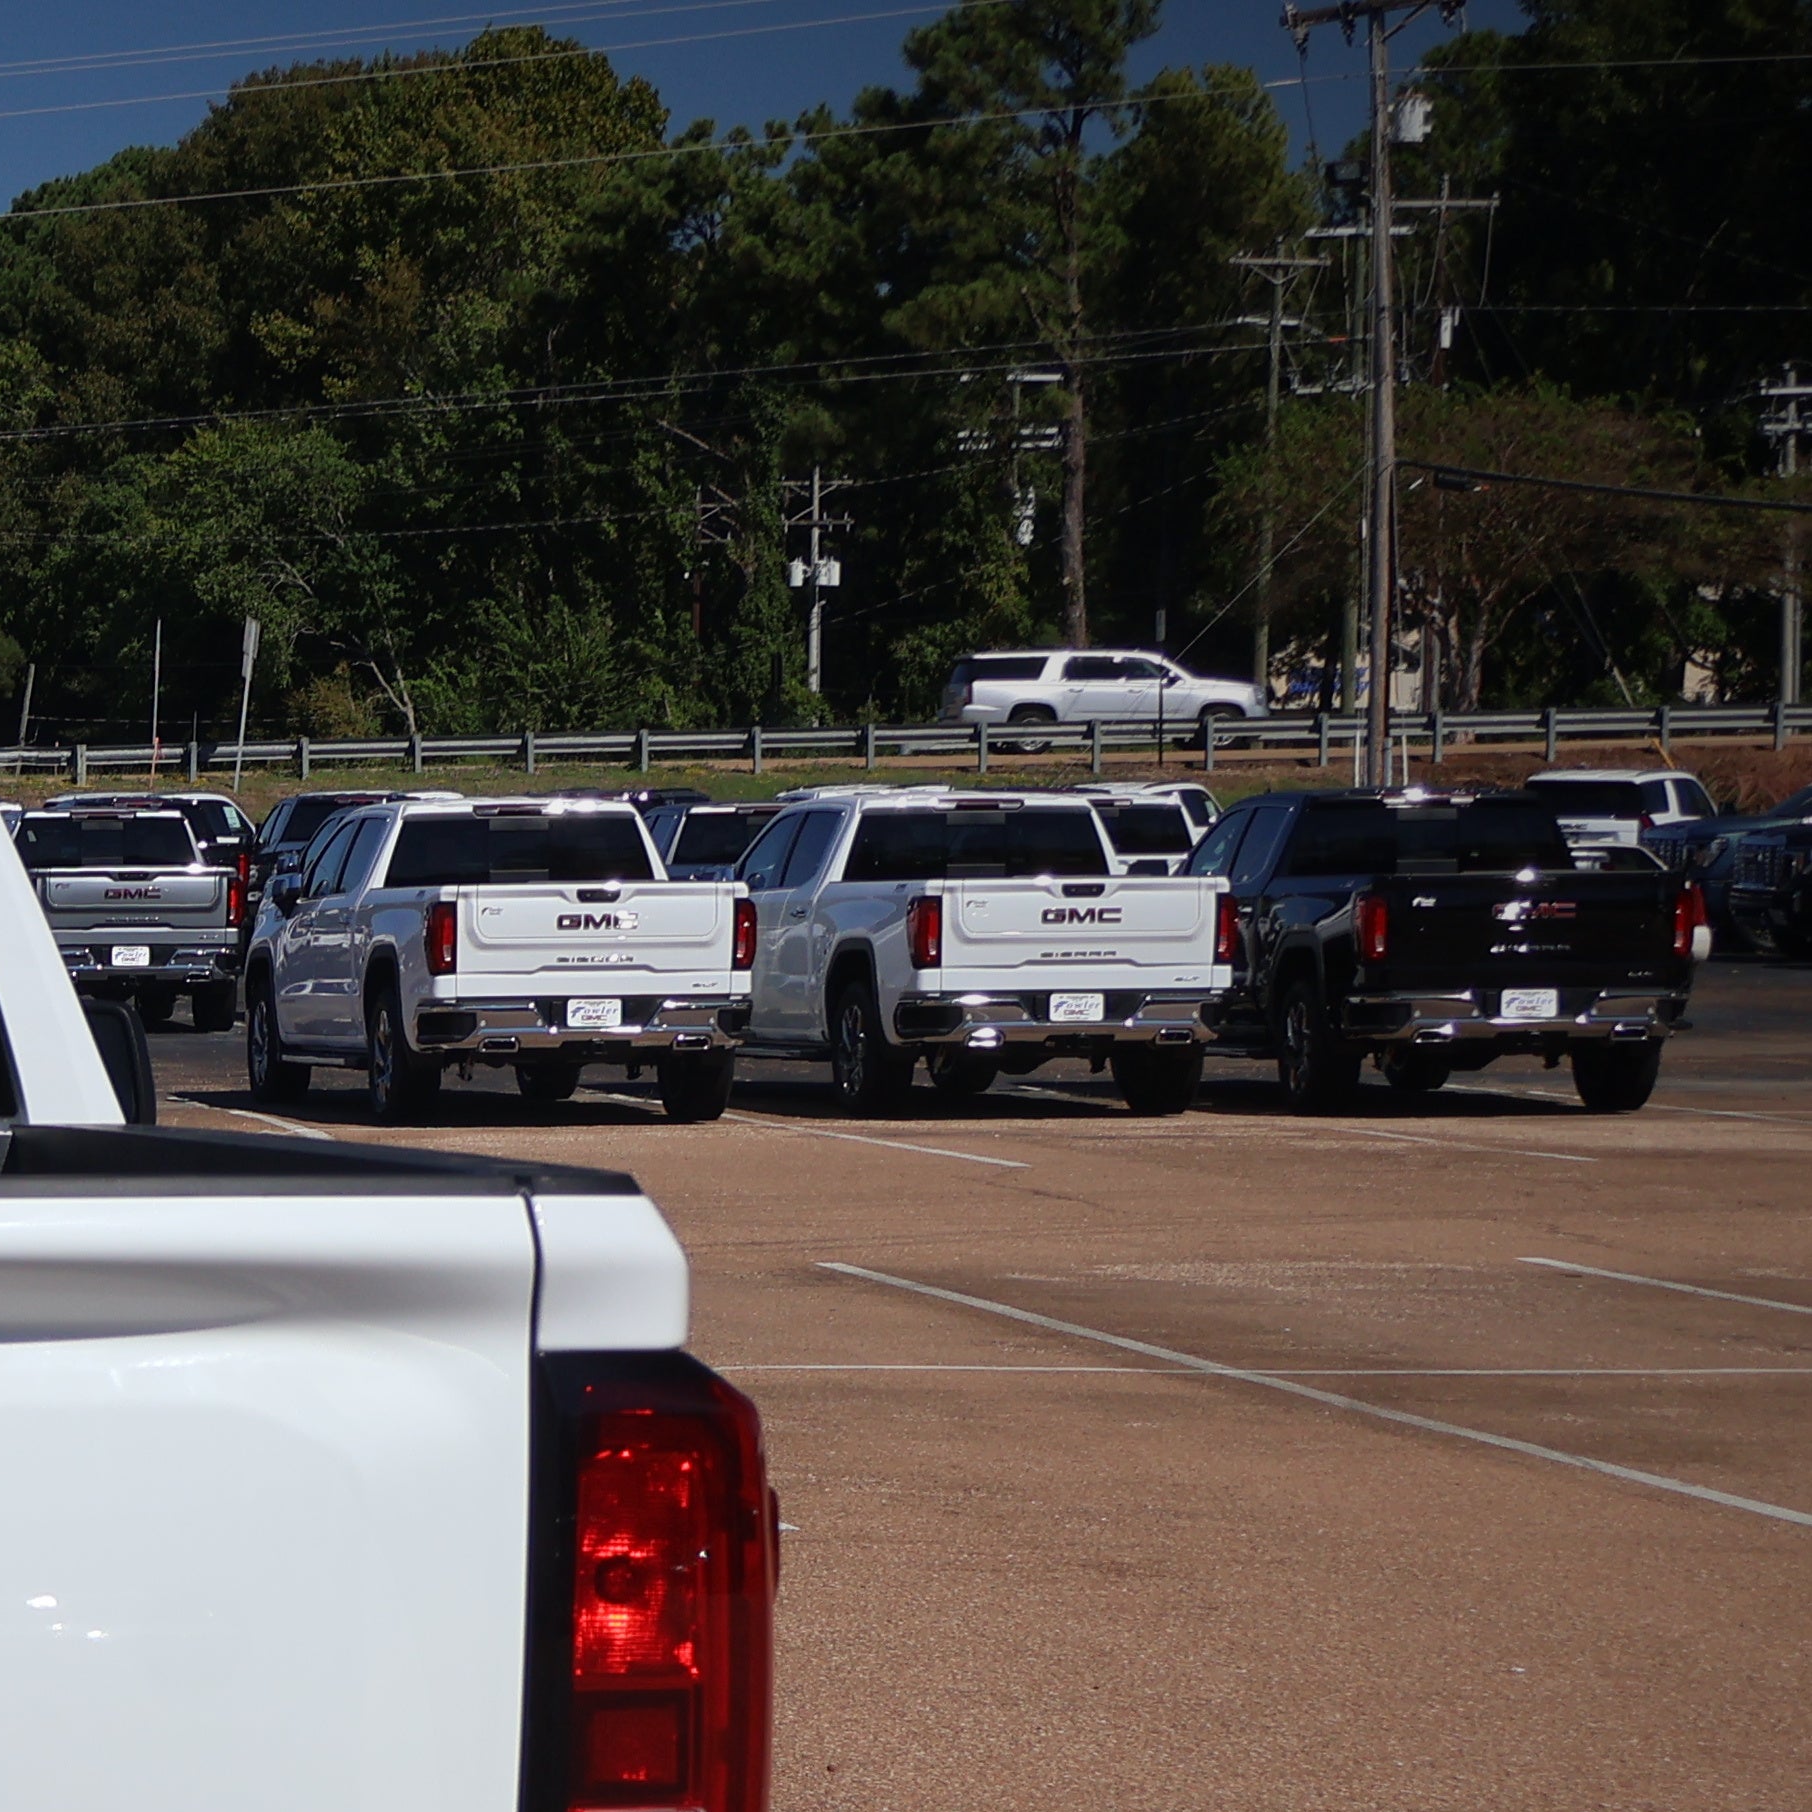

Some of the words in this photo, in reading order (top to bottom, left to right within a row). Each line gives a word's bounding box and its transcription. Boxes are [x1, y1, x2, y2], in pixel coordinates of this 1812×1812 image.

[104, 887, 162, 900] GMC
[556, 912, 639, 931] GMC
[1041, 906, 1122, 925] GMC
